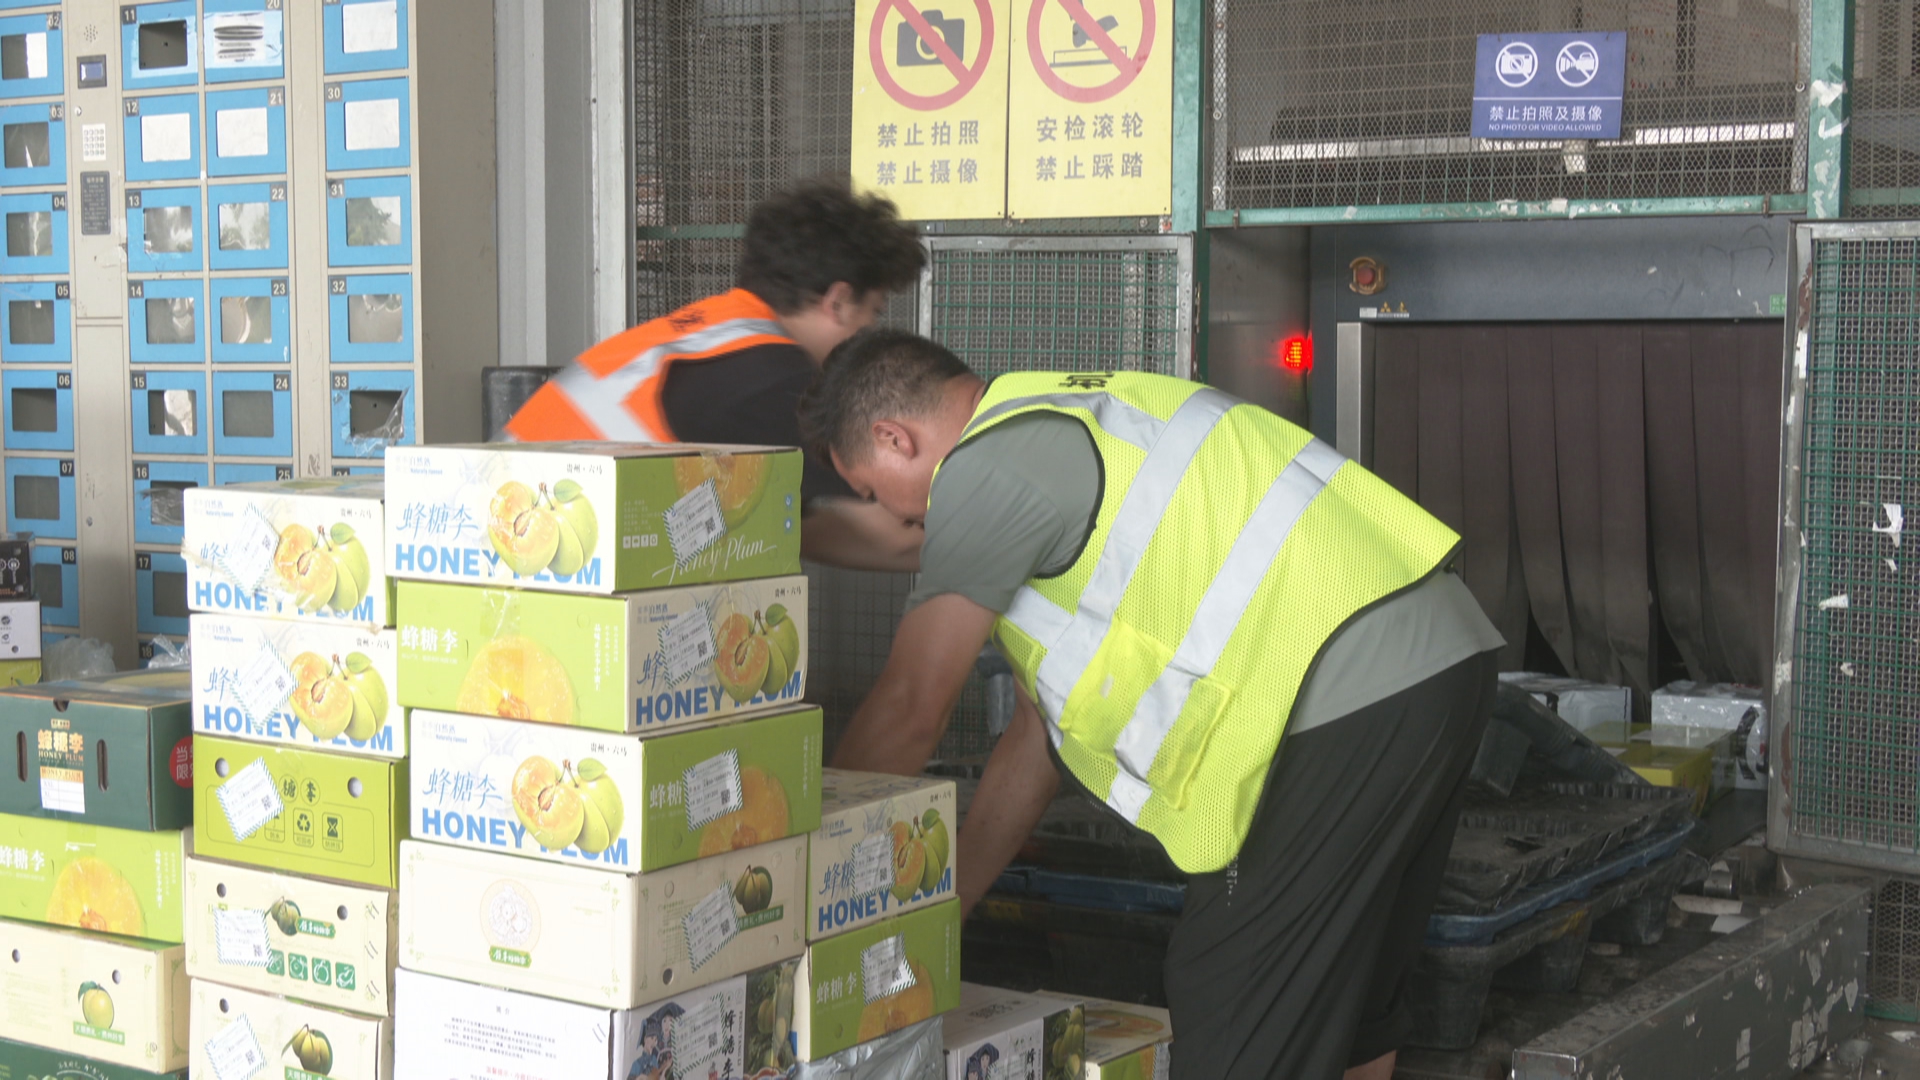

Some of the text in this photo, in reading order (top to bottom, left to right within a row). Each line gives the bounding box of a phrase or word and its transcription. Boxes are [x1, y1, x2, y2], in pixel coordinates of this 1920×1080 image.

[267, 0, 280, 9] 20
[48, 14, 60, 27] 02
[125, 10, 136, 22] 11
[270, 92, 282, 105] 21
[327, 87, 340, 100] 30
[51, 106, 63, 119] 03
[126, 102, 138, 114] 12
[1489, 105, 1602, 121] 禁止拍照及摄像
[1036, 111, 1144, 142] 安检滚轮
[877, 120, 980, 148] 禁止拍照
[877, 158, 979, 186] 禁止摄像
[1036, 152, 1144, 181] 禁止踩踏
[271, 188, 284, 200] 22
[330, 183, 343, 197] 31
[54, 196, 66, 209] 04
[128, 195, 140, 207] 13
[57, 285, 69, 297] 05
[130, 285, 142, 297] 14
[273, 282, 286, 295] 23
[332, 280, 345, 293] 32
[58, 375, 70, 386] 06
[134, 376, 145, 388] 15
[275, 378, 288, 390] 24
[334, 375, 347, 388] 33
[61, 462, 73, 474] 07
[136, 467, 147, 478] 16
[278, 469, 291, 480] 25
[396, 501, 479, 541] 蜂糖李
[63, 550, 75, 561] 08
[724, 533, 777, 571] Plum
[138, 557, 149, 569] 17
[395, 543, 500, 578] HONEY
[401, 625, 458, 653] 蜂糖李
[635, 684, 725, 727] HONEY
[38, 750, 84, 762] HONEY PLUM
[176, 744, 193, 763] 当
[176, 764, 193, 781] 限
[422, 768, 503, 810] 蜂糖李
[422, 807, 526, 849] HONEY
[0, 845, 45, 872] 蜂糖李
[818, 889, 890, 933] HONEY
[816, 971, 858, 1005] 蜂糖李
